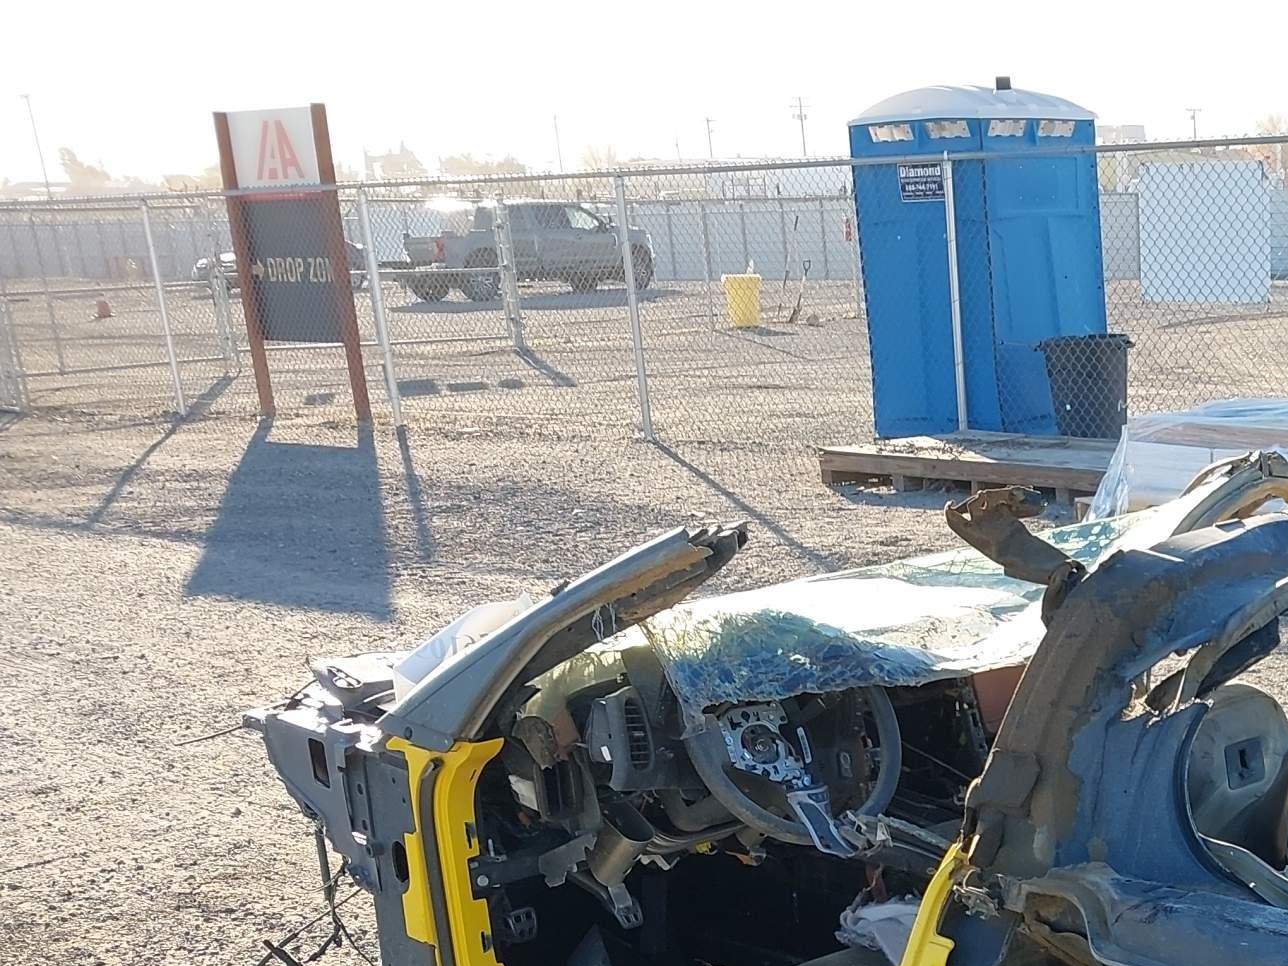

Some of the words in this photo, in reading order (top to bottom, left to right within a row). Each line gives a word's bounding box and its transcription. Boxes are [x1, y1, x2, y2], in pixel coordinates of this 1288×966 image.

[899, 165, 941, 177] Diamond
[266, 257, 304, 282] DROP
[307, 257, 335, 282] ZON
